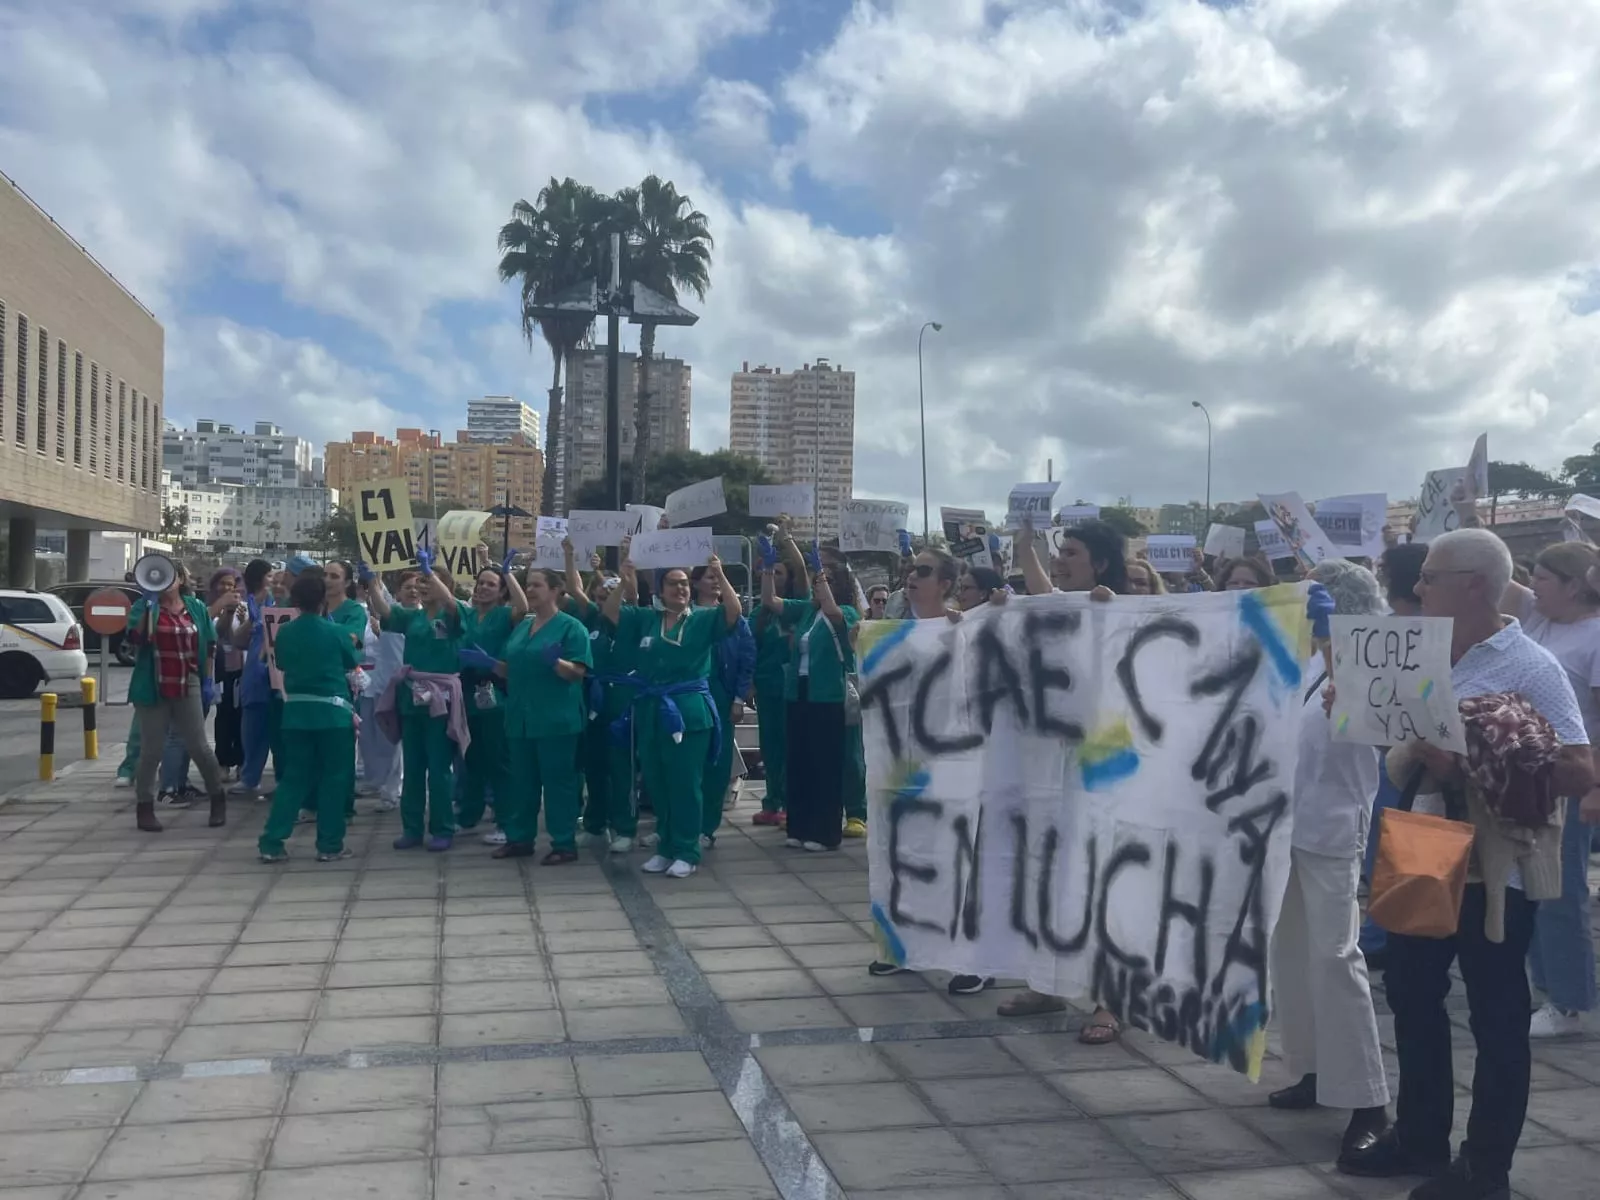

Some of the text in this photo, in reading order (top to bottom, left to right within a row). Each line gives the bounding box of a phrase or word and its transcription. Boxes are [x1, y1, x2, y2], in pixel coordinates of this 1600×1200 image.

[361, 488, 395, 521] C1
[361, 528, 417, 565] YA!
[441, 546, 479, 580] YA!
[1351, 627, 1422, 671] TCAE
[861, 611, 1085, 760] TCAE
[1375, 711, 1426, 741] YA
[888, 798, 1268, 1012] EN LUCHA
